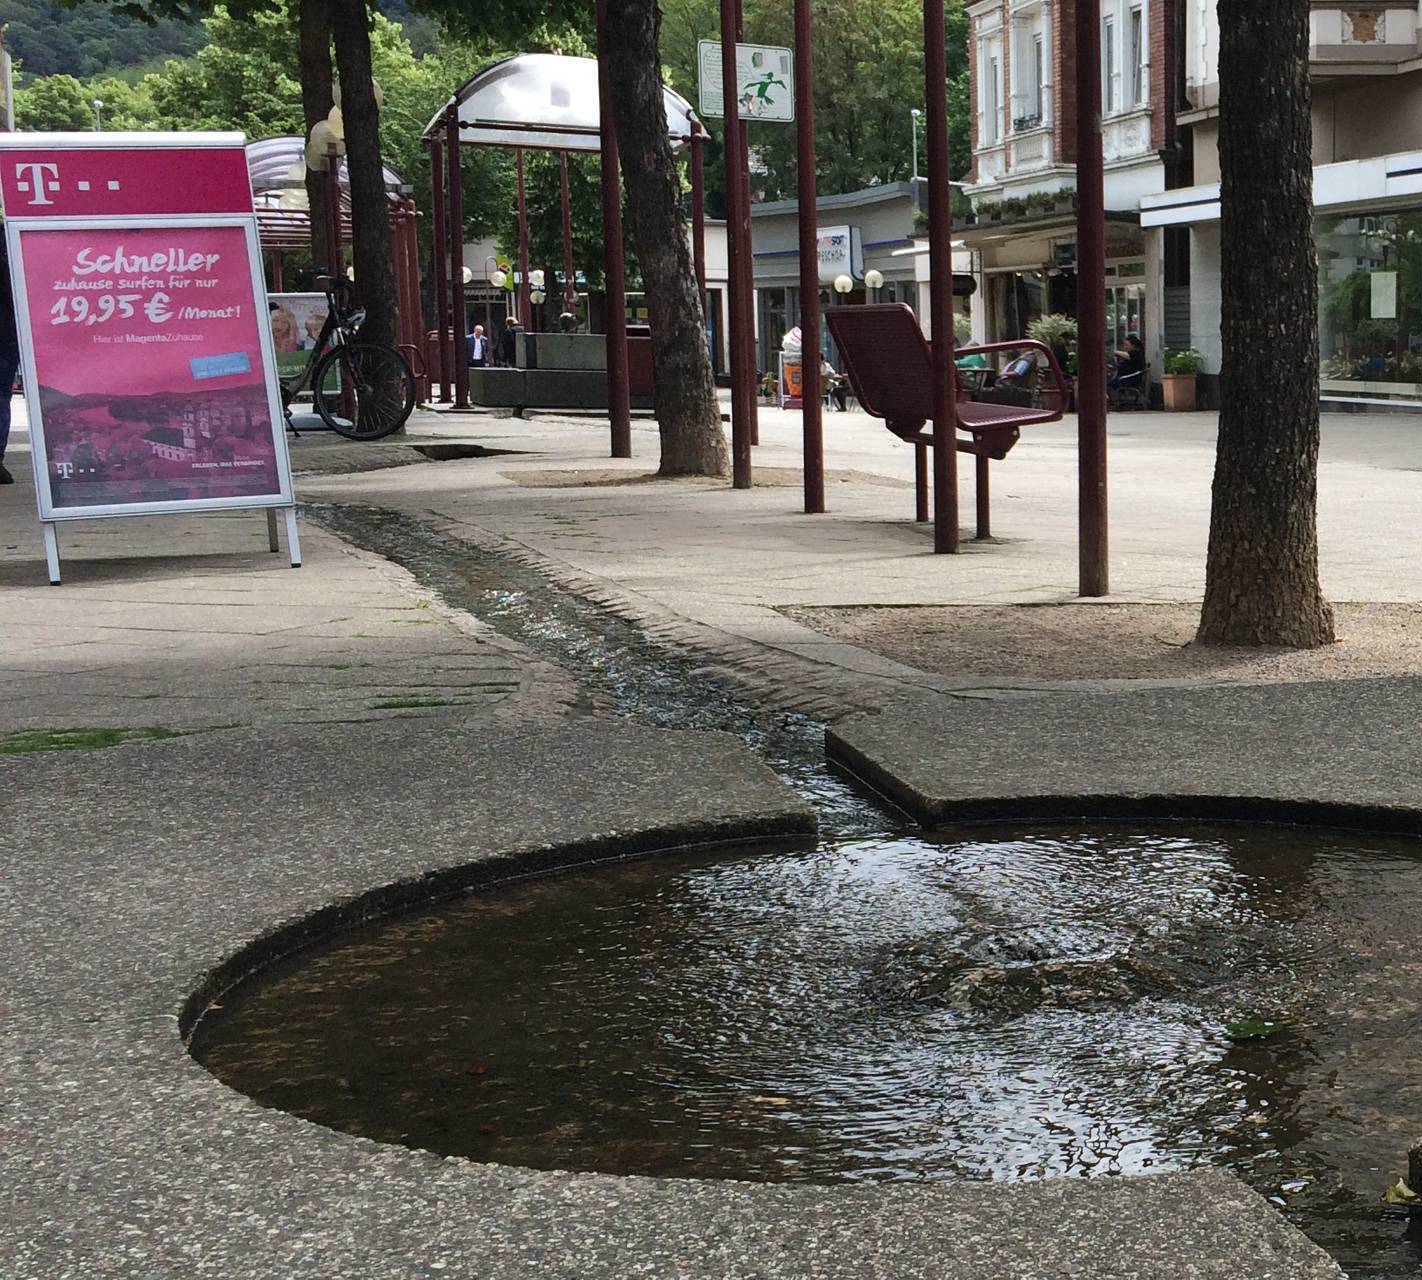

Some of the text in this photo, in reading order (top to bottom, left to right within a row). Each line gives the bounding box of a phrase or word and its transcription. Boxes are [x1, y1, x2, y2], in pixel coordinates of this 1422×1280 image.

[72, 246, 221, 275] Schneller
[53, 275, 219, 290] zuhause surfen für nur
[50, 291, 241, 326] 19,95 € /Monat!
[93, 334, 204, 345] Hier ist MagentaZuhause
